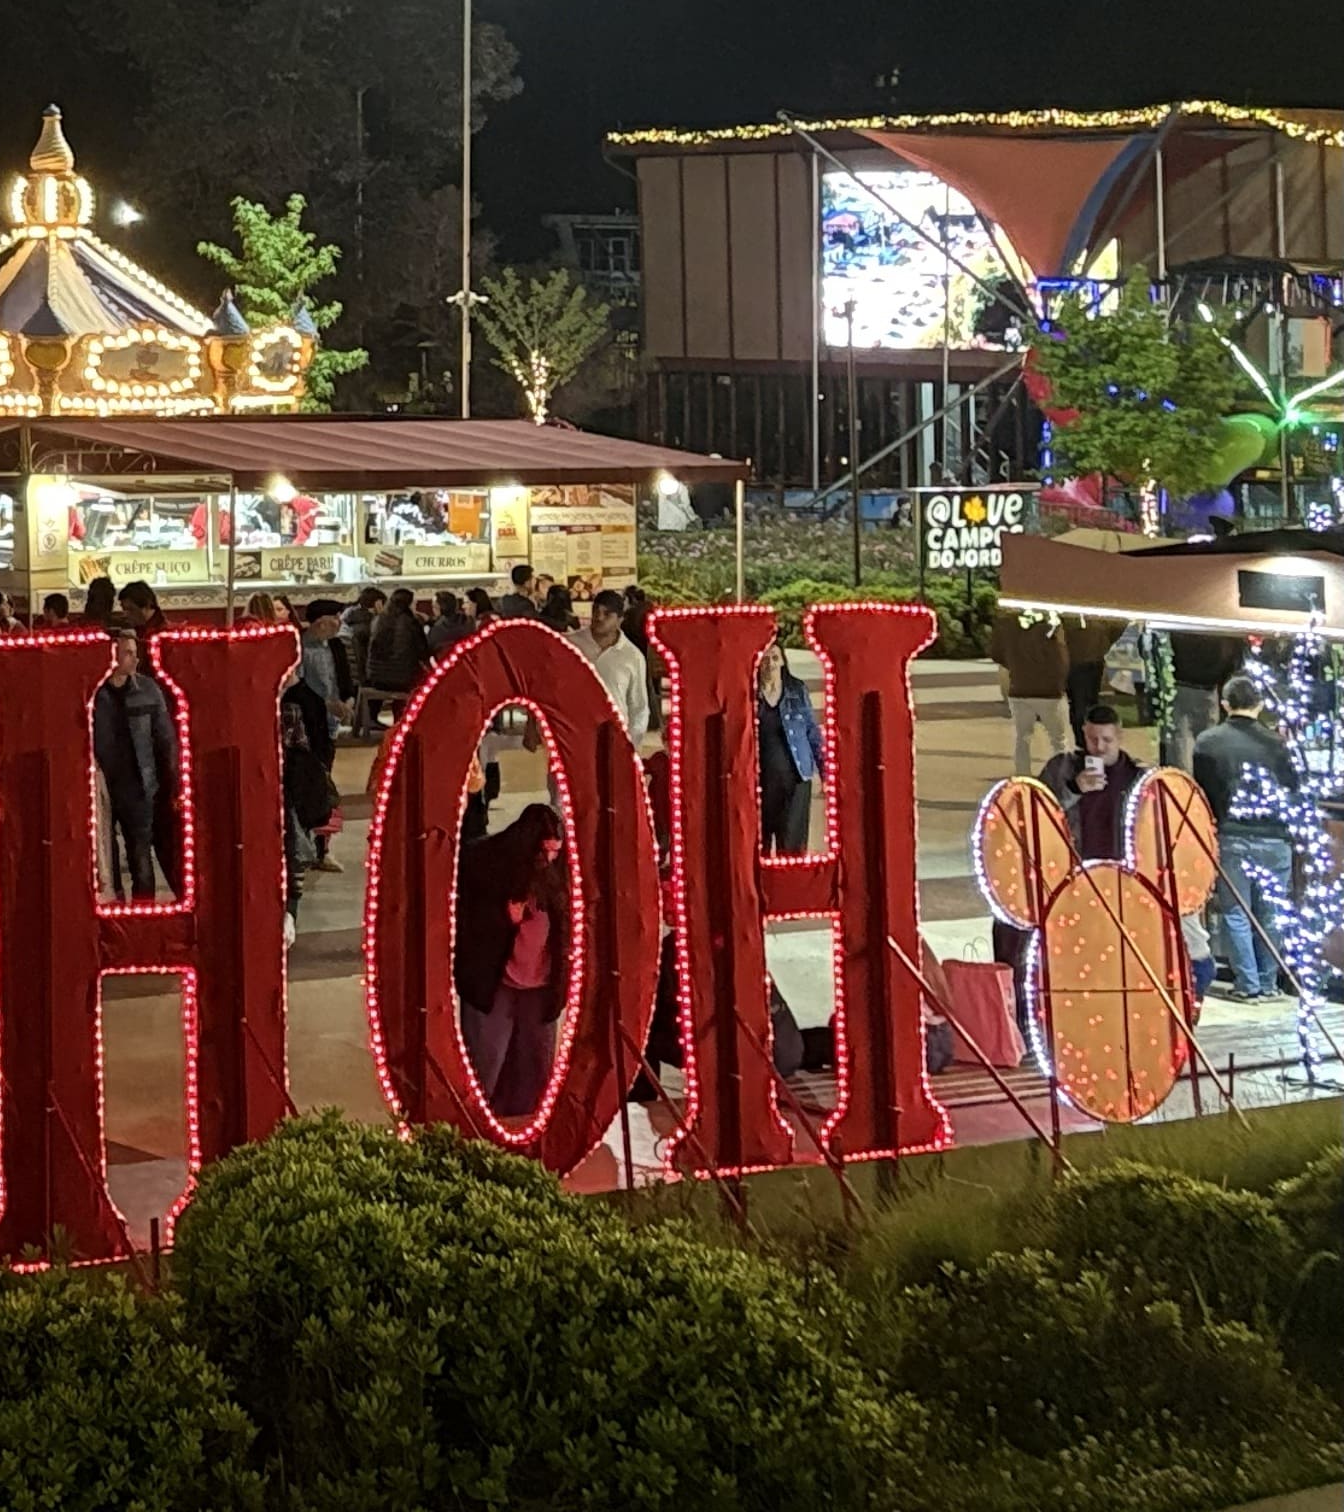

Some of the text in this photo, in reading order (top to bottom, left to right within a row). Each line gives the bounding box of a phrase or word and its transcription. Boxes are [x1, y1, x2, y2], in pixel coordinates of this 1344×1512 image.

[115, 559, 153, 575] CRÊPE
[269, 553, 304, 571] CRÊPE
[415, 556, 467, 569] CHURROS
